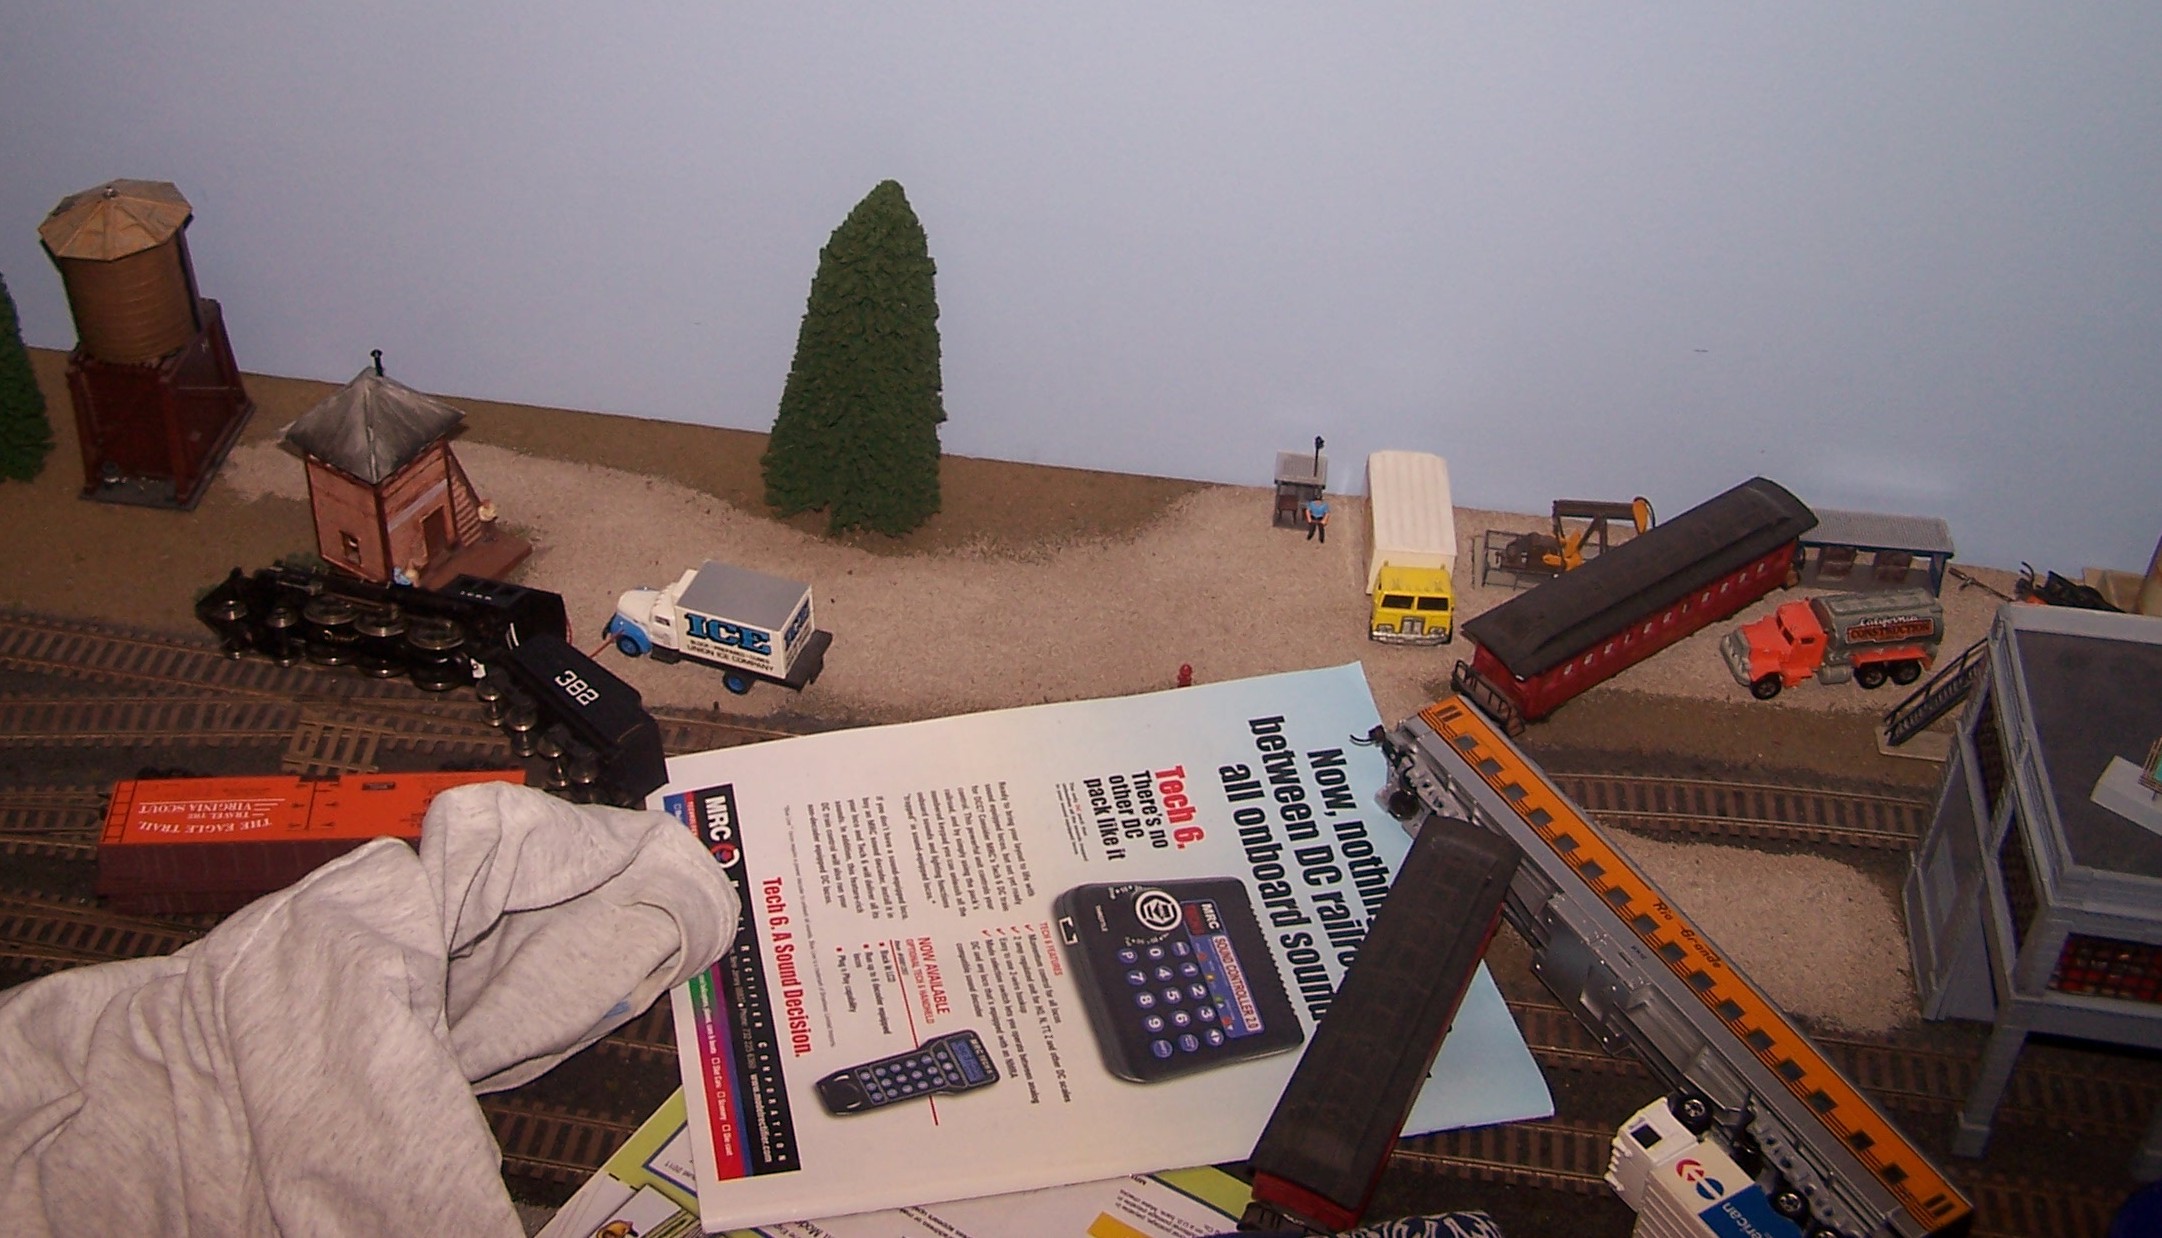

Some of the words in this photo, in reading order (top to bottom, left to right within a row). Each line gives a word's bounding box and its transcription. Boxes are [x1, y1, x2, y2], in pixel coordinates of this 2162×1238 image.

[685, 613, 771, 655] ICE
[1850, 623, 1930, 640] CONSTRUCTION
[731, 656, 773, 671] COMPANY
[555, 670, 599, 705] 382
[1083, 778, 1112, 815] pack
[1109, 775, 1134, 815] other
[1155, 766, 1195, 823] Tech
[1219, 764, 1263, 802] all
[1250, 717, 1318, 840] between
[138, 805, 185, 814] SCOUT
[189, 802, 251, 812] VIRGINIA
[240, 818, 270, 830] THE
[705, 796, 731, 841] MRC
[1132, 770, 1162, 826] There's
[1149, 829, 1168, 848] no
[139, 821, 179, 833] TRAIL
[185, 823, 234, 833] EAGLE
[1097, 817, 1119, 846] like
[1121, 818, 1144, 839] DC
[1173, 826, 1204, 849] 6.
[1308, 749, 1356, 816] Now,
[1335, 821, 1406, 927] nothin
[1106, 849, 1126, 860] it
[1235, 808, 1309, 927] onboard
[1297, 845, 1341, 886] DC
[763, 877, 786, 913] Tech
[769, 916, 789, 930] 6.
[1201, 903, 1220, 929] MRC
[1316, 892, 1374, 971] railro
[1653, 897, 1673, 920] Rio
[1680, 926, 1721, 968] Grande
[772, 932, 792, 942] A
[918, 937, 935, 961] NOW
[775, 944, 801, 987] Sound
[906, 939, 919, 968] OPTIONAL
[920, 990, 934, 1023] HANDHELD
[1214, 938, 1234, 963] SOUND
[1226, 964, 1254, 1015] CONTROLLER
[1245, 1017, 1259, 1029] 2.0
[925, 964, 950, 1014] AVAILABLE
[783, 989, 811, 1057] Decision.
[750, 1074, 772, 1162] www.modelrectifier.com
[758, 1042, 786, 1161] CORPORATION
[1722, 1202, 1762, 1238] erican
